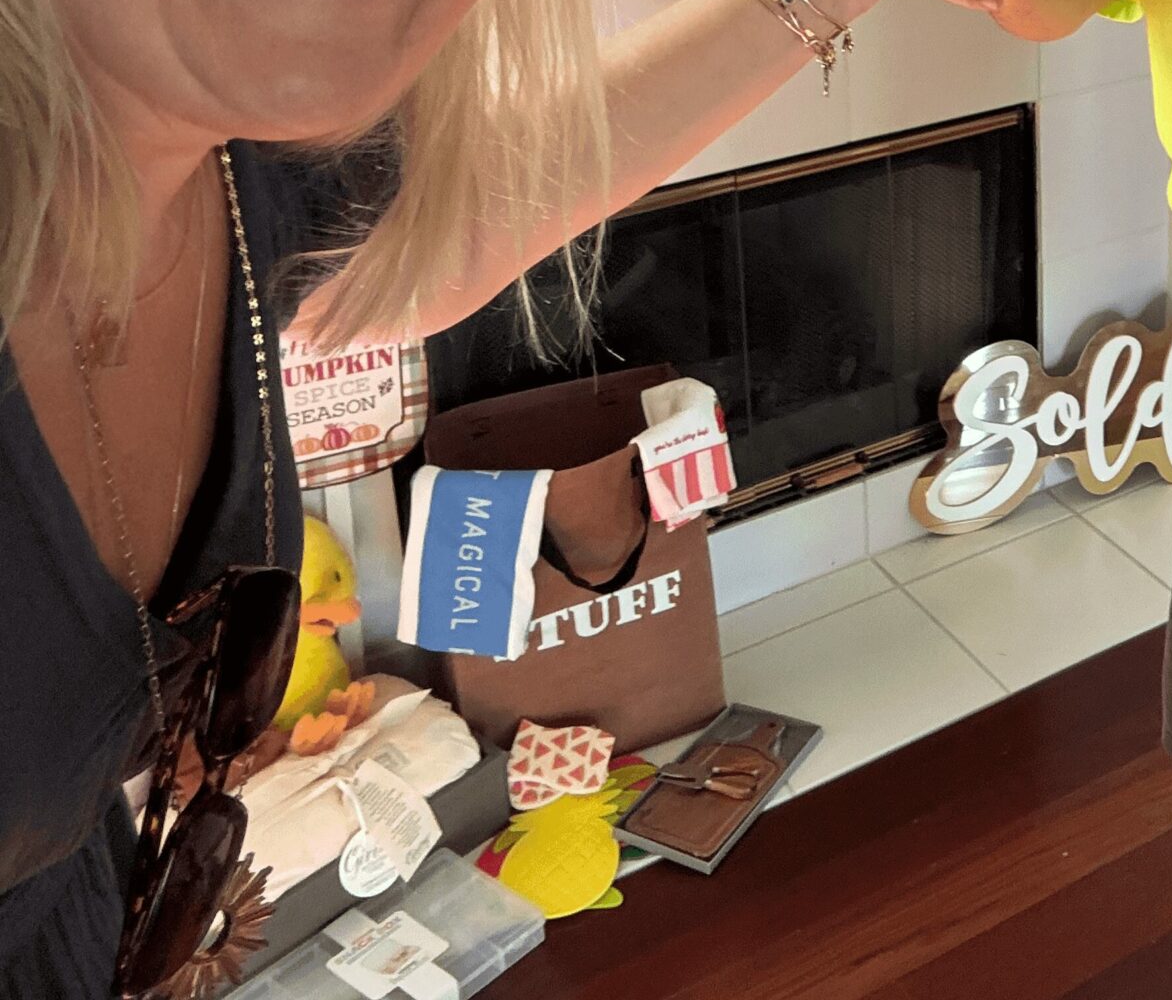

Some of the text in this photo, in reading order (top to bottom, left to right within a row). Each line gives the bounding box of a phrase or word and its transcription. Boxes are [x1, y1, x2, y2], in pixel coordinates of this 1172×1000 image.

[282, 346, 394, 388] UMPKIN
[286, 395, 376, 428] SEASON
[294, 377, 371, 407] SPICE
[449, 495, 493, 631] MAGICAL
[526, 569, 683, 652] TUFF
